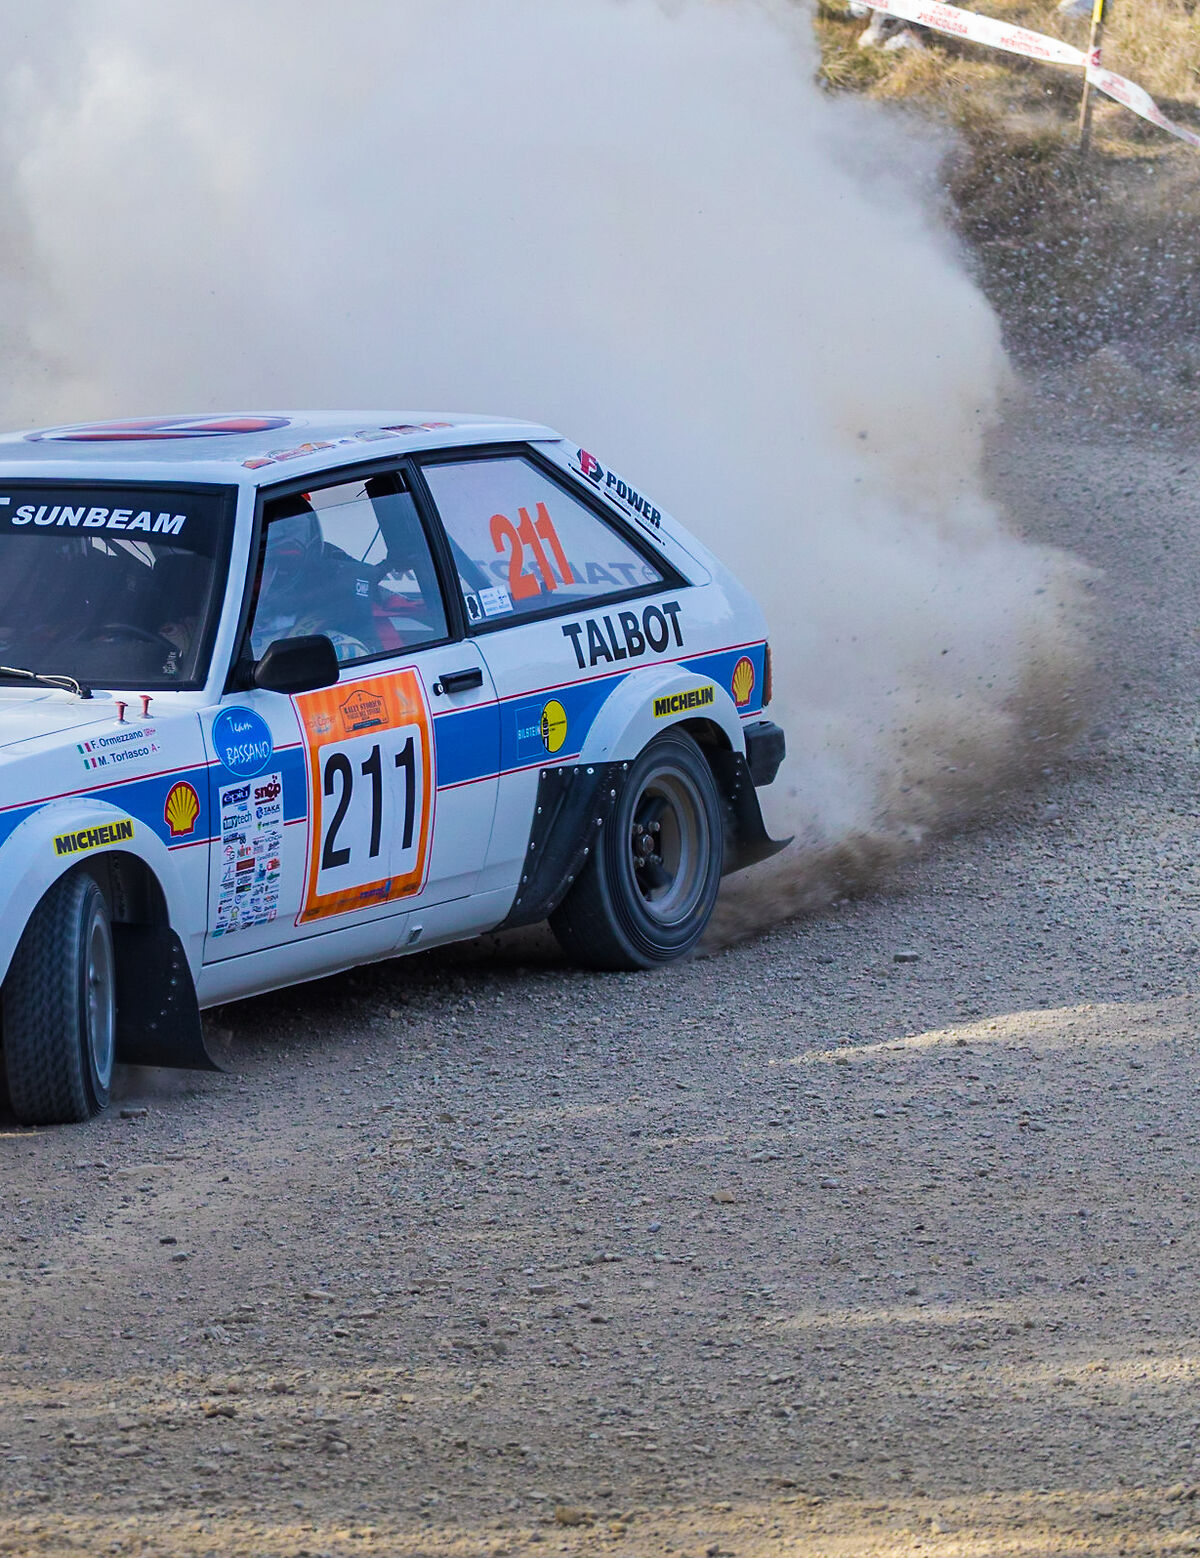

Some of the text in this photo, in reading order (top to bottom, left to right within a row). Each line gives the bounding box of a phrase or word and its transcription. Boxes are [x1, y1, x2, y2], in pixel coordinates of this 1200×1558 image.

[605, 471, 662, 529] POWER
[11, 505, 187, 536] SUNBEAM
[489, 502, 575, 600] 211
[561, 601, 684, 670] TALBOT
[654, 686, 714, 717] MICHELIN
[99, 730, 144, 747] Ormezzano
[226, 741, 270, 767] BASSANO
[97, 755, 110, 766] M.
[110, 746, 150, 763] Torlasco
[321, 736, 416, 871] 211
[55, 820, 133, 855] MICHELIN
